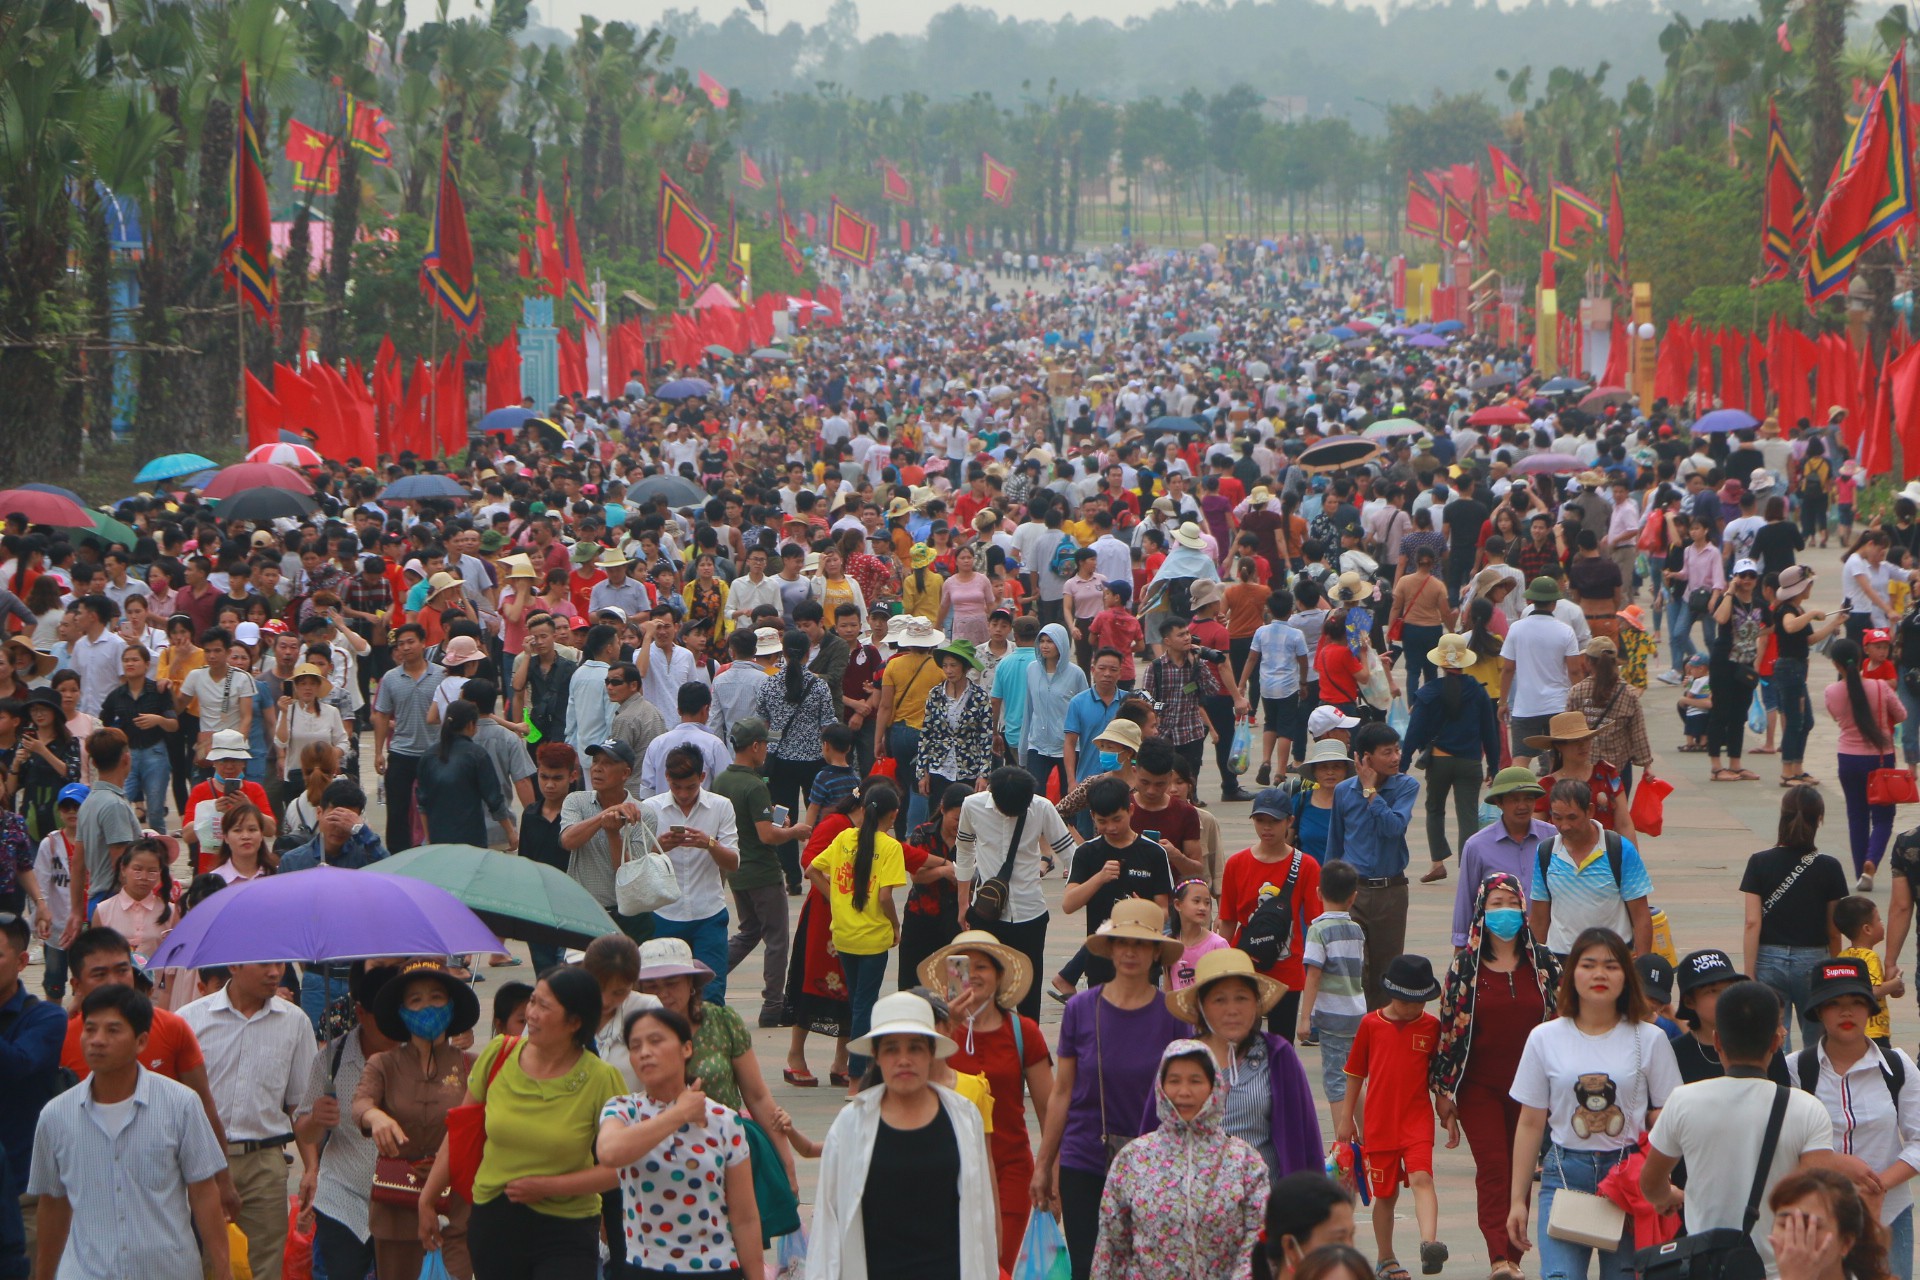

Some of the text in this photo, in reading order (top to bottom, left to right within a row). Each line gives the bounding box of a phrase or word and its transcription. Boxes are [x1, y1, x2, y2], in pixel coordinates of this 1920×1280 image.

[1250, 934, 1275, 945] Supreme
[1692, 953, 1719, 966] NEW
[1693, 959, 1727, 973] YORK
[1826, 968, 1855, 977] Supreme
